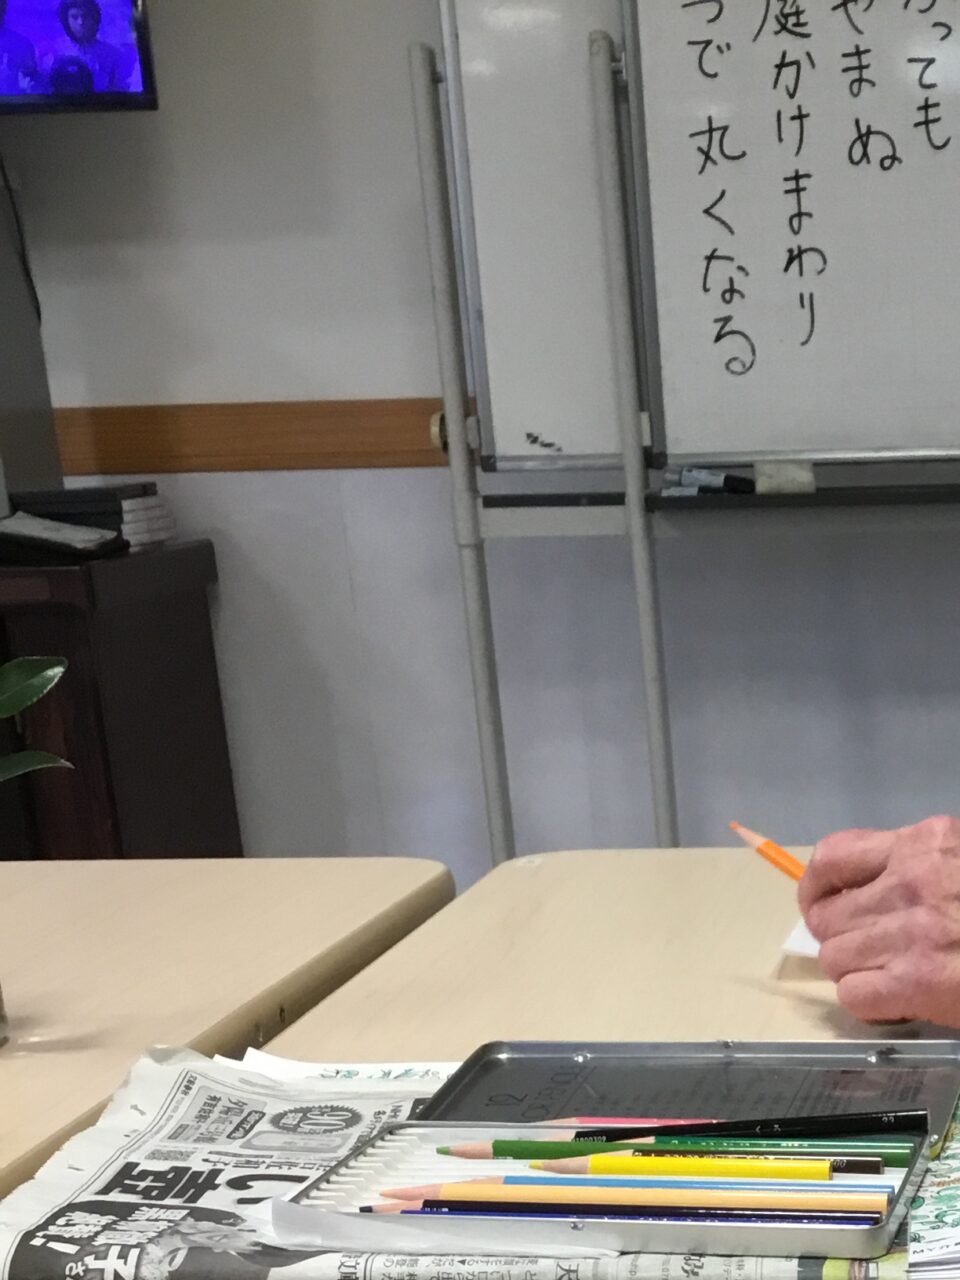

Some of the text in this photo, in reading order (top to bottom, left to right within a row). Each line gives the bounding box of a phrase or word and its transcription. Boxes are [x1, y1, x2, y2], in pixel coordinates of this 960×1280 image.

[832, 0, 903, 171] やまぬ
[688, 115, 757, 376] 丸くなる
